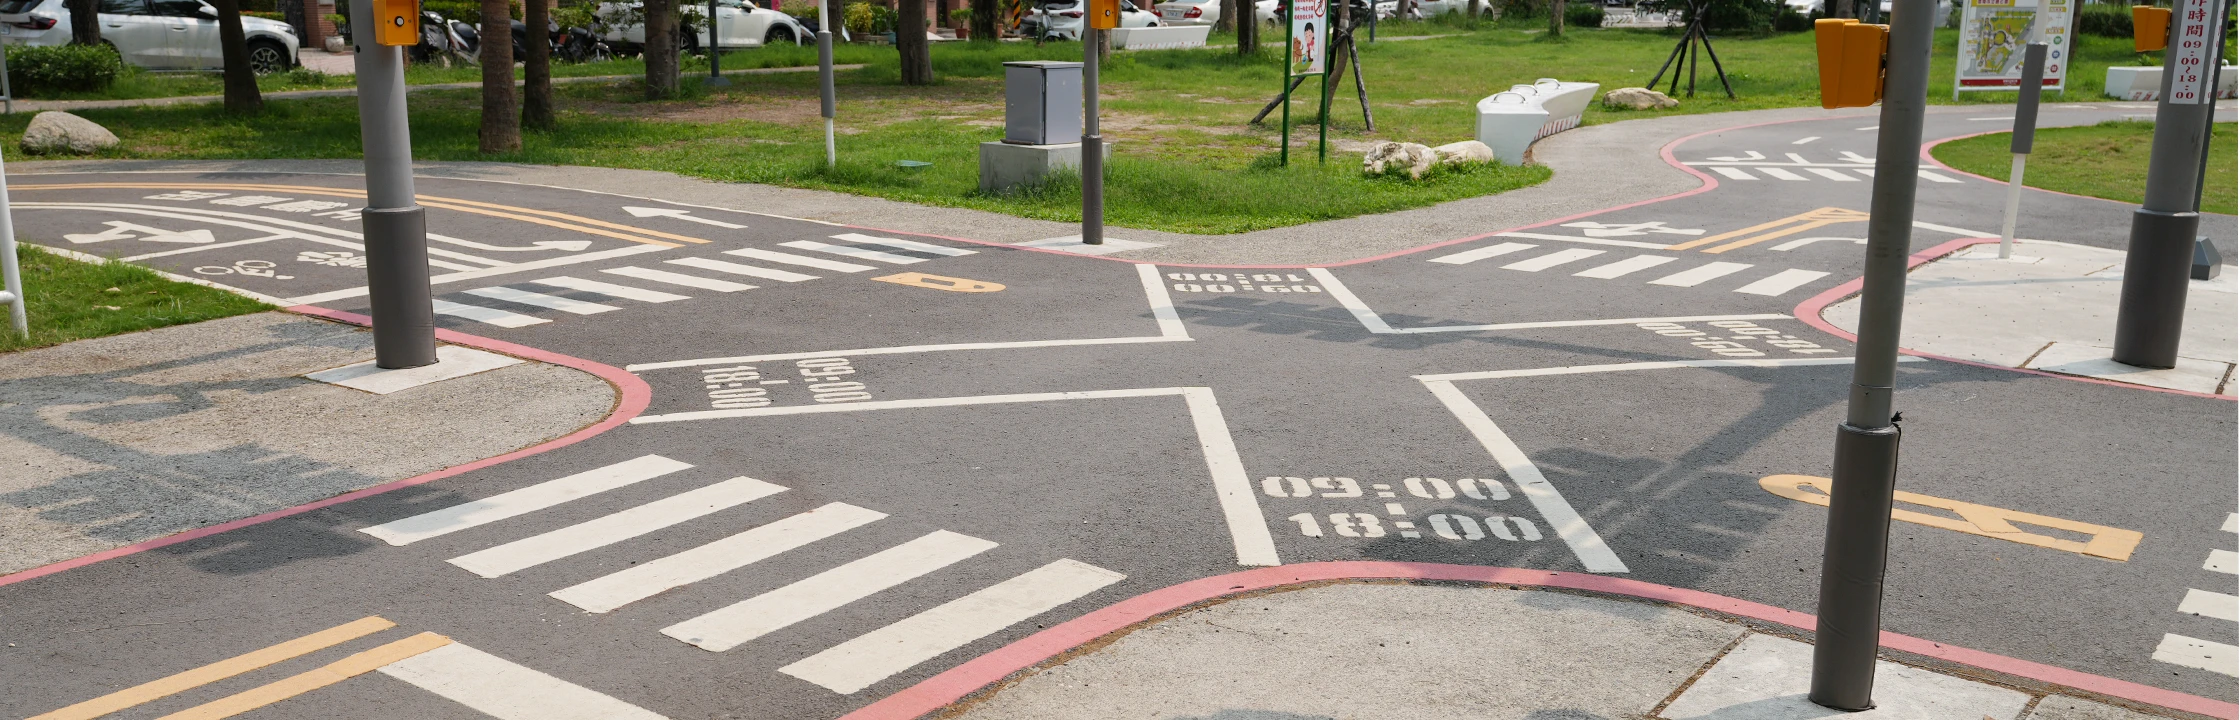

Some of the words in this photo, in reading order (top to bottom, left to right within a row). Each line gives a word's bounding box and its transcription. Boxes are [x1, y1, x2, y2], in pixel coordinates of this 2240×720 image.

[1173, 283, 1322, 293] 09:00
[1635, 321, 1766, 357] 09:00
[1707, 320, 1839, 355] 18:00
[702, 365, 771, 408] 18:00
[796, 357, 872, 403] 09:00
[1260, 476, 1512, 501] 09:00
[1288, 512, 1543, 541] 18:00
